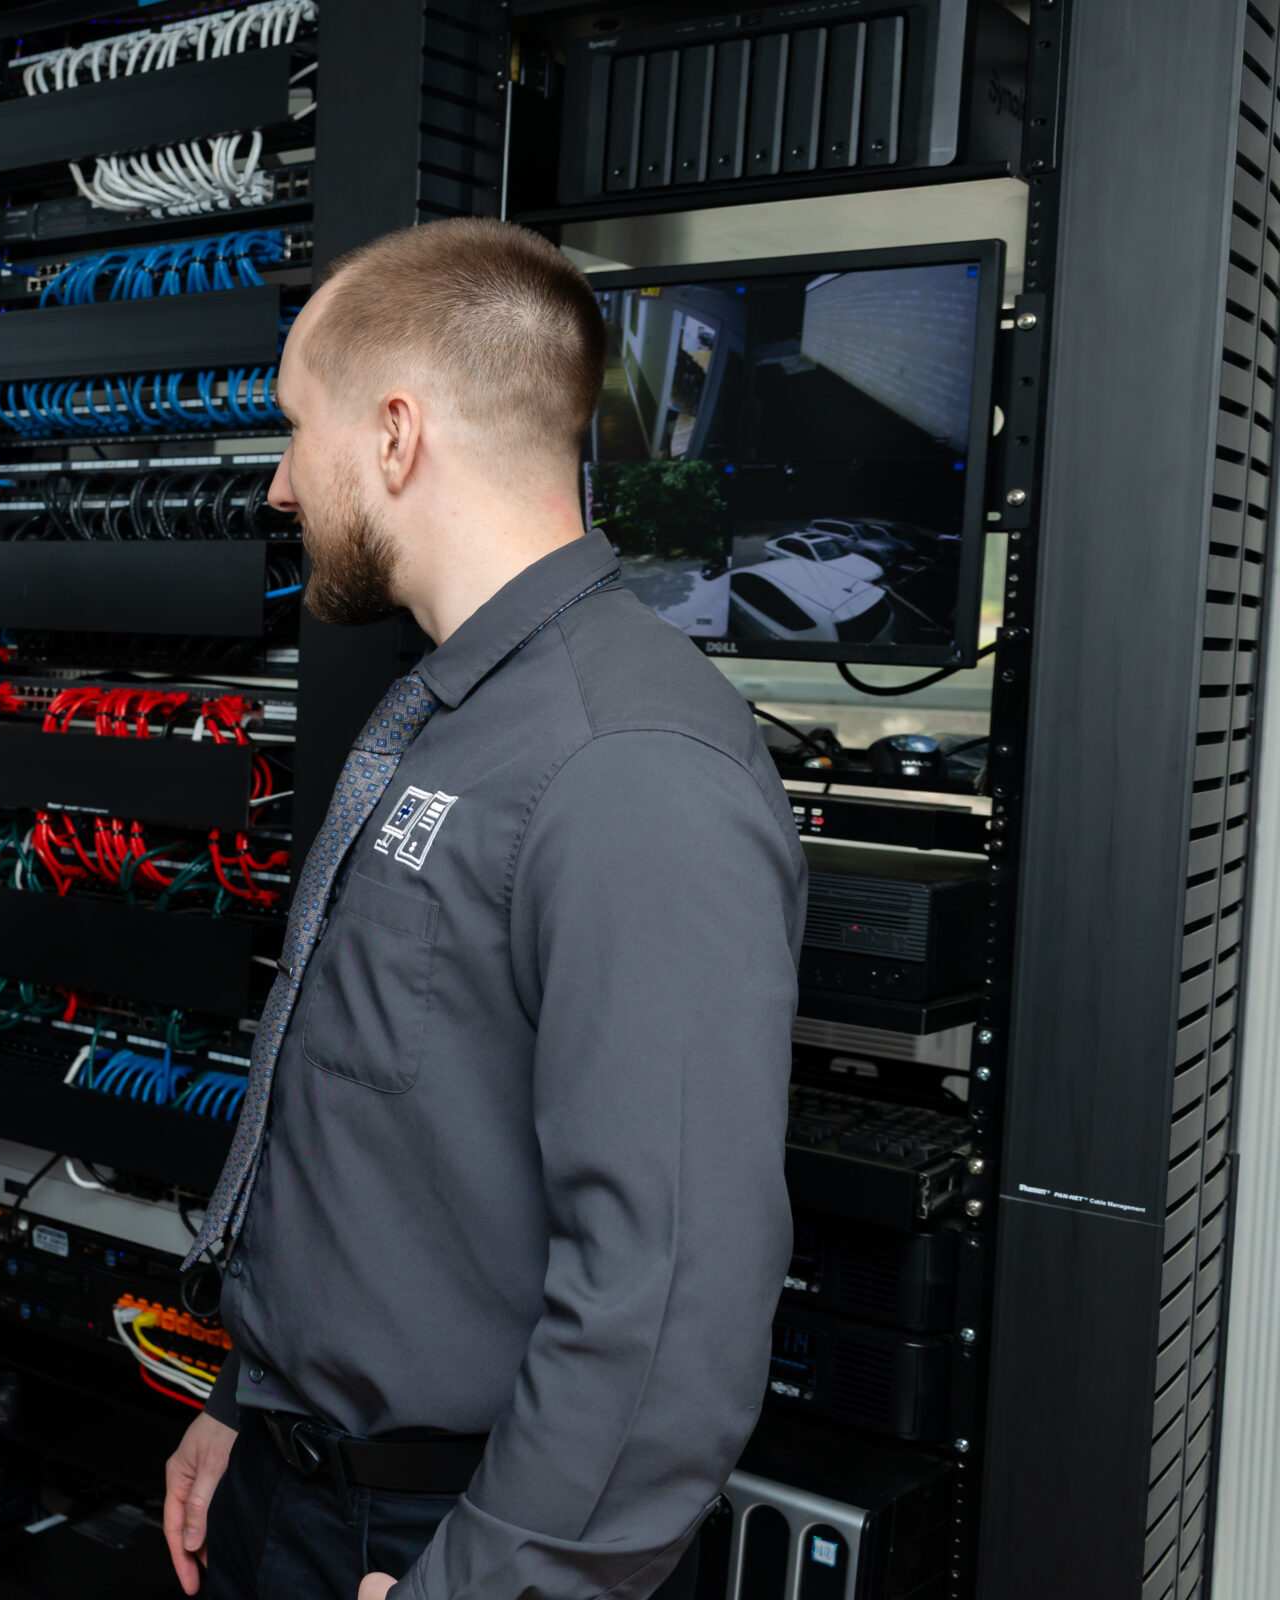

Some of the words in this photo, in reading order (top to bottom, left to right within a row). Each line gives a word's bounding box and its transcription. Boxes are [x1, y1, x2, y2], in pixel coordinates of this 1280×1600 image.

[706, 641, 738, 654] DELL
[1089, 1198, 1107, 1207] Cable
[1107, 1201, 1146, 1213] Management
